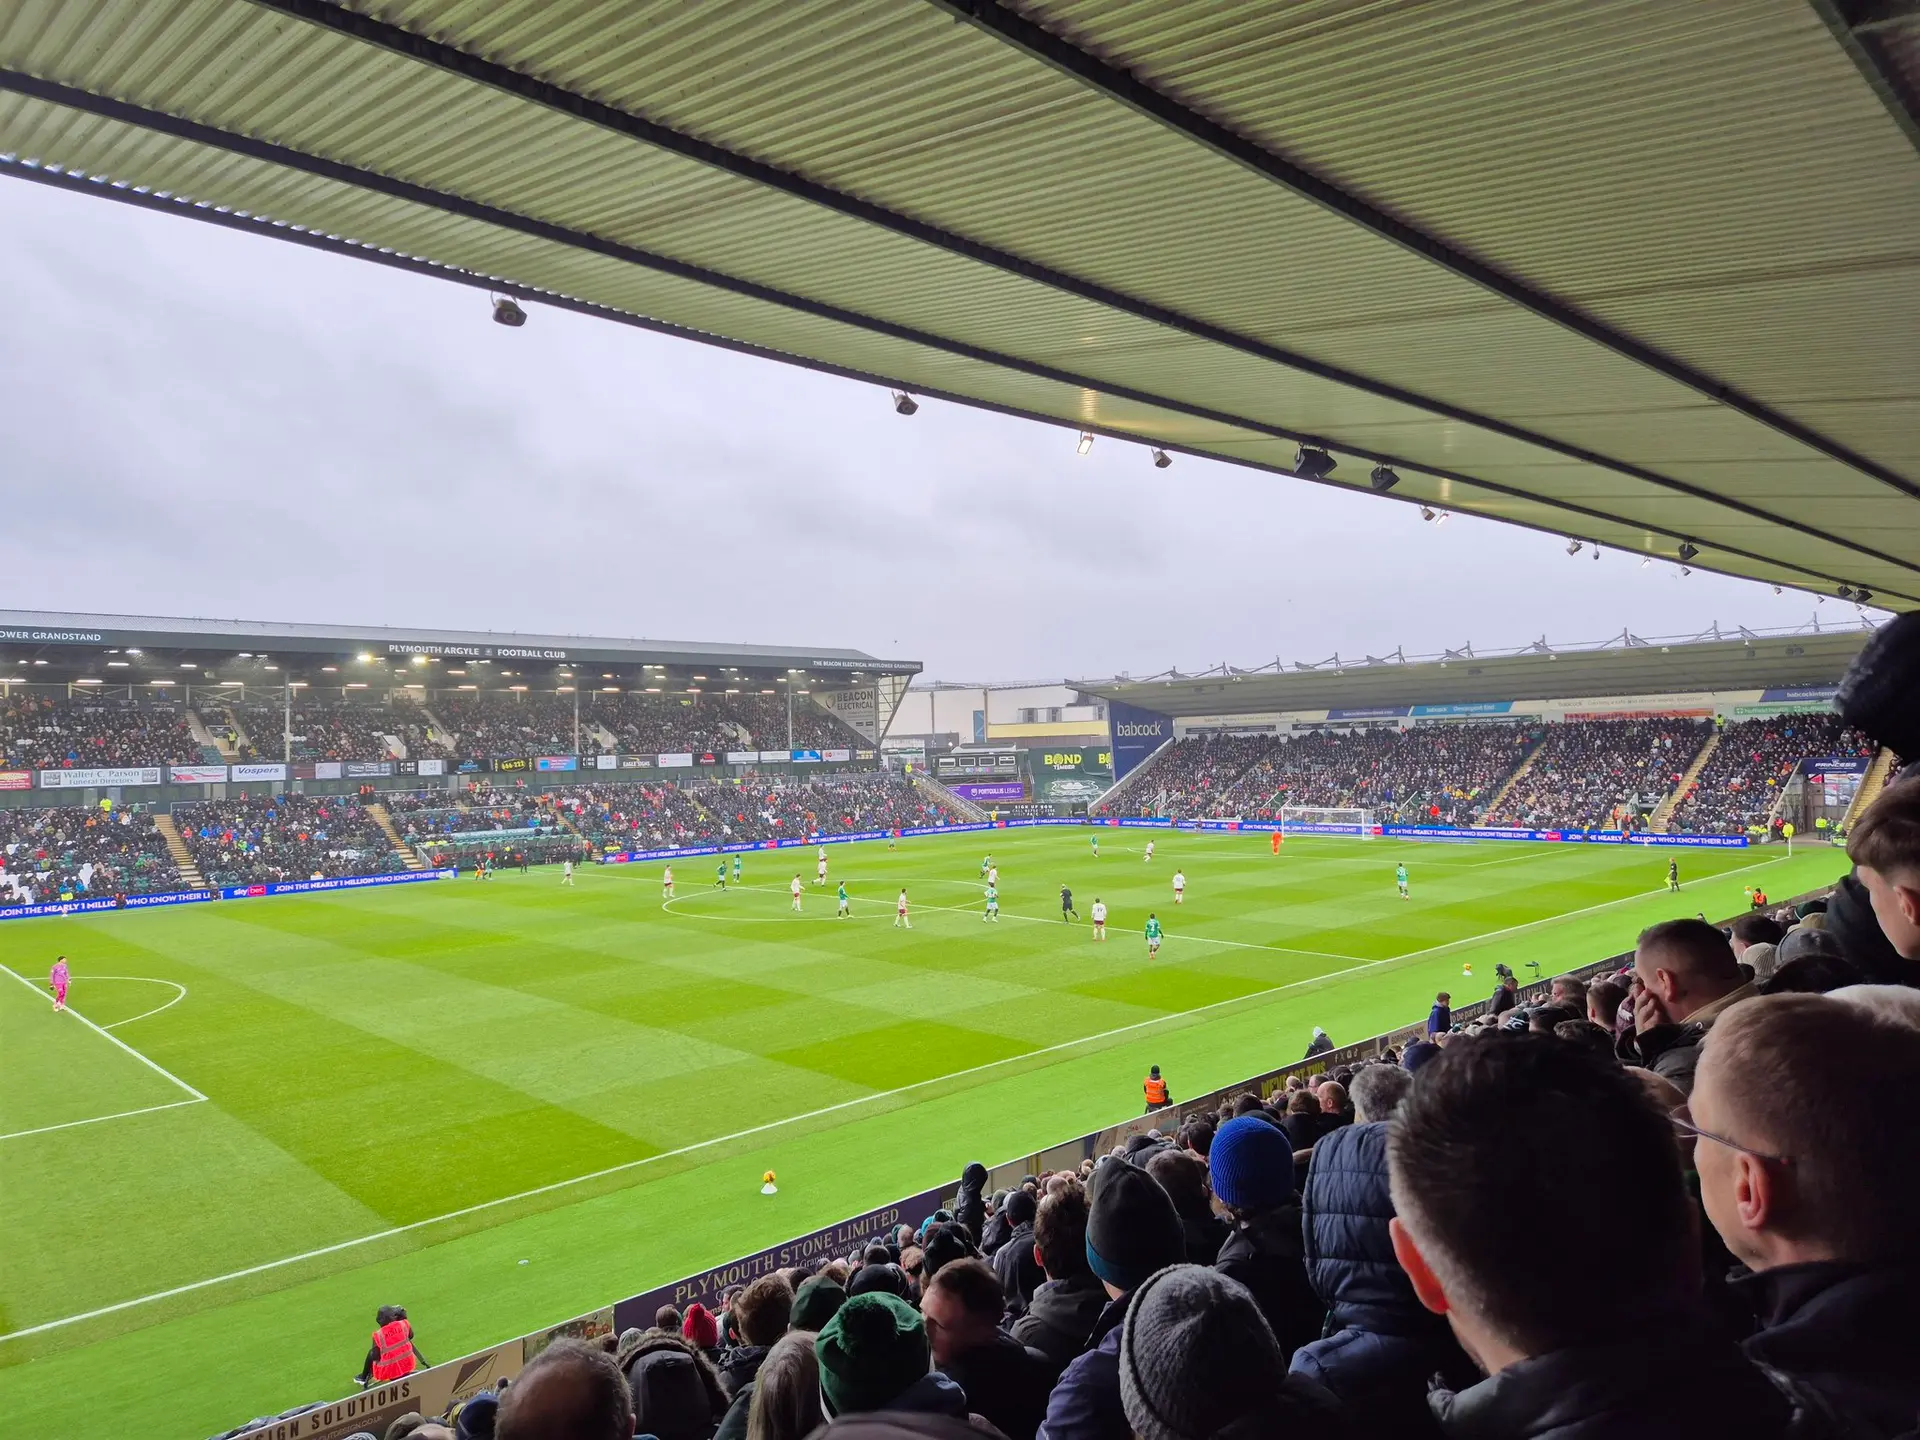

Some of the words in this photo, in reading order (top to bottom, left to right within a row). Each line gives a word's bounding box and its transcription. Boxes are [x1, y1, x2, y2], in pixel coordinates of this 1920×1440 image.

[32, 632, 101, 642] GRANDSTAND
[389, 644, 442, 654] PLYMOUTH
[444, 647, 480, 656] ARGYLE
[498, 648, 542, 658] FOOTBALL
[544, 650, 566, 659] CLUB
[837, 691, 873, 702] BEACON
[837, 701, 873, 710] ELECTRICAL
[1117, 721, 1163, 736] babcock
[1044, 753, 1083, 765] BOND
[238, 766, 280, 775] Vospers
[820, 835, 838, 843] MILLION
[1677, 836, 1701, 844] KNOW
[1702, 837, 1722, 845] THEIR
[657, 850, 677, 858] NEARLY
[728, 844, 742, 852] THEIR
[275, 883, 292, 892] JOIN
[293, 882, 310, 891] THE
[311, 879, 339, 889] NEARLY
[344, 876, 374, 886] MILLION
[375, 875, 393, 884] WHO
[393, 873, 416, 882] KNOW
[416, 871, 435, 880] THEIR
[233, 888, 248, 897] sky
[249, 885, 264, 894] bet
[0, 908, 23, 917] JOIN
[24, 906, 42, 915] THE
[44, 903, 80, 914] NEARLY
[126, 897, 143, 906] WHO
[150, 894, 176, 904] KNOW
[177, 892, 201, 902] THEIR
[1514, 984, 1548, 1005] FAIRWAY
[1457, 1011, 1464, 1019] be
[1464, 1008, 1477, 1019] part
[1477, 1005, 1485, 1014] of
[1307, 1061, 1326, 1076] THIS
[831, 1239, 868, 1257] Worktops
[675, 1253, 775, 1304] PLYMOUTH
[780, 1231, 834, 1265] STONE
[837, 1208, 899, 1242] LIMITED
[245, 1420, 299, 1440] SIGN
[311, 1381, 410, 1430] SOLUTIONS
